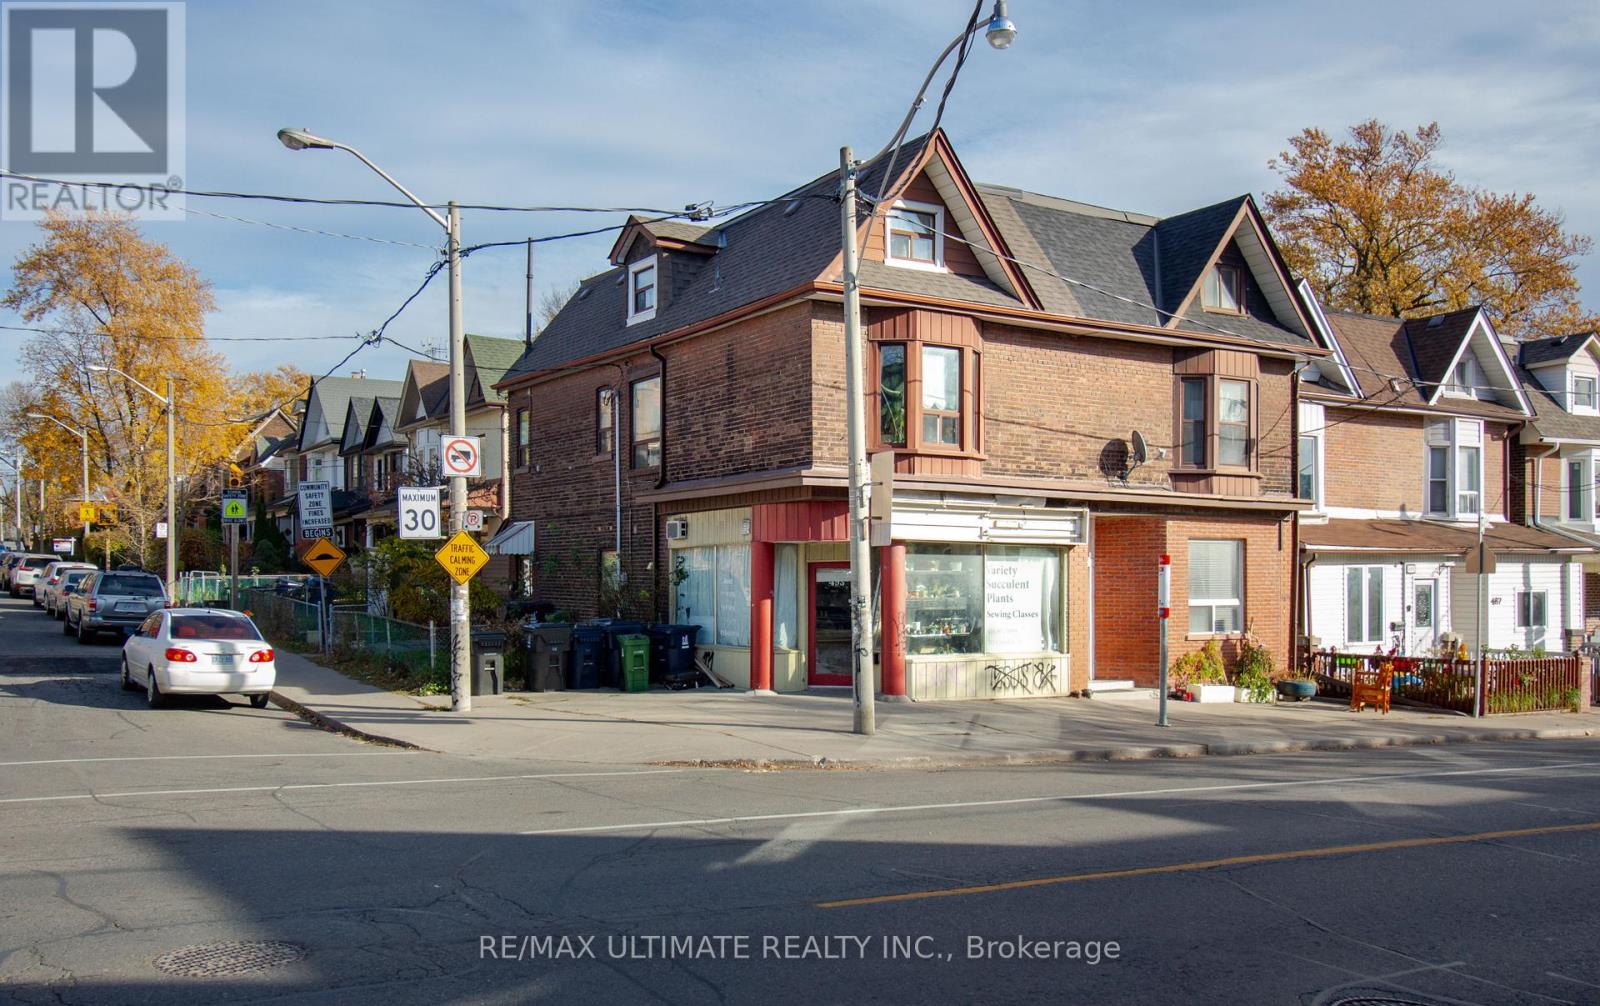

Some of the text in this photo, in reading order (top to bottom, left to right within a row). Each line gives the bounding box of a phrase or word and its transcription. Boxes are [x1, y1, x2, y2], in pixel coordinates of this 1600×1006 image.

[402, 493, 436, 502] MAXIMUM
[404, 509, 436, 531] 30
[304, 529, 331, 537] BEGINS
[450, 543, 474, 553] TRAFFIC
[449, 555, 476, 564] CALMING
[455, 567, 470, 576] ZONE
[986, 593, 1014, 603] Plants
[986, 609, 1039, 620] Sewing Classes
